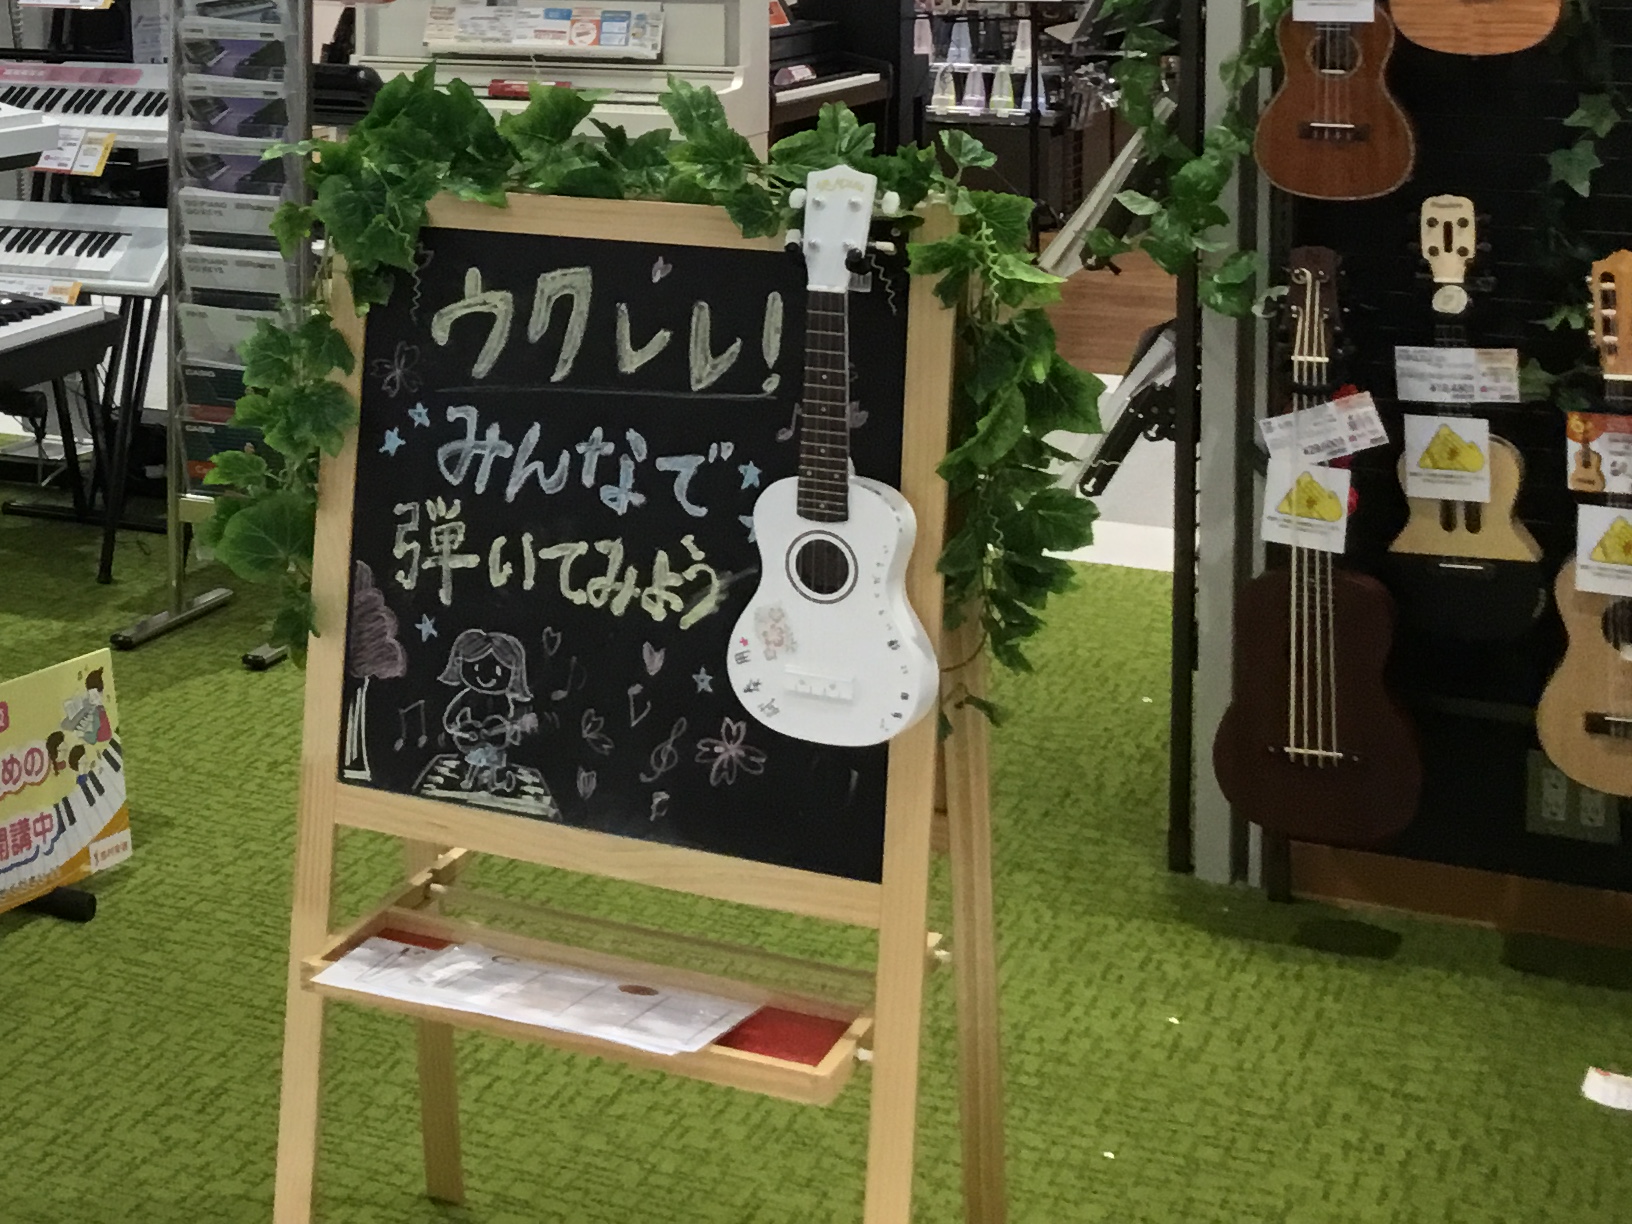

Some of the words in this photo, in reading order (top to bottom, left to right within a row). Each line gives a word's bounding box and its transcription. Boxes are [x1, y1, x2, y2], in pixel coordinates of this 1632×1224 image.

[430, 266, 784, 394] ウクレレ!
[437, 405, 735, 517] みんなで
[393, 496, 728, 630] 弾いてみよう
